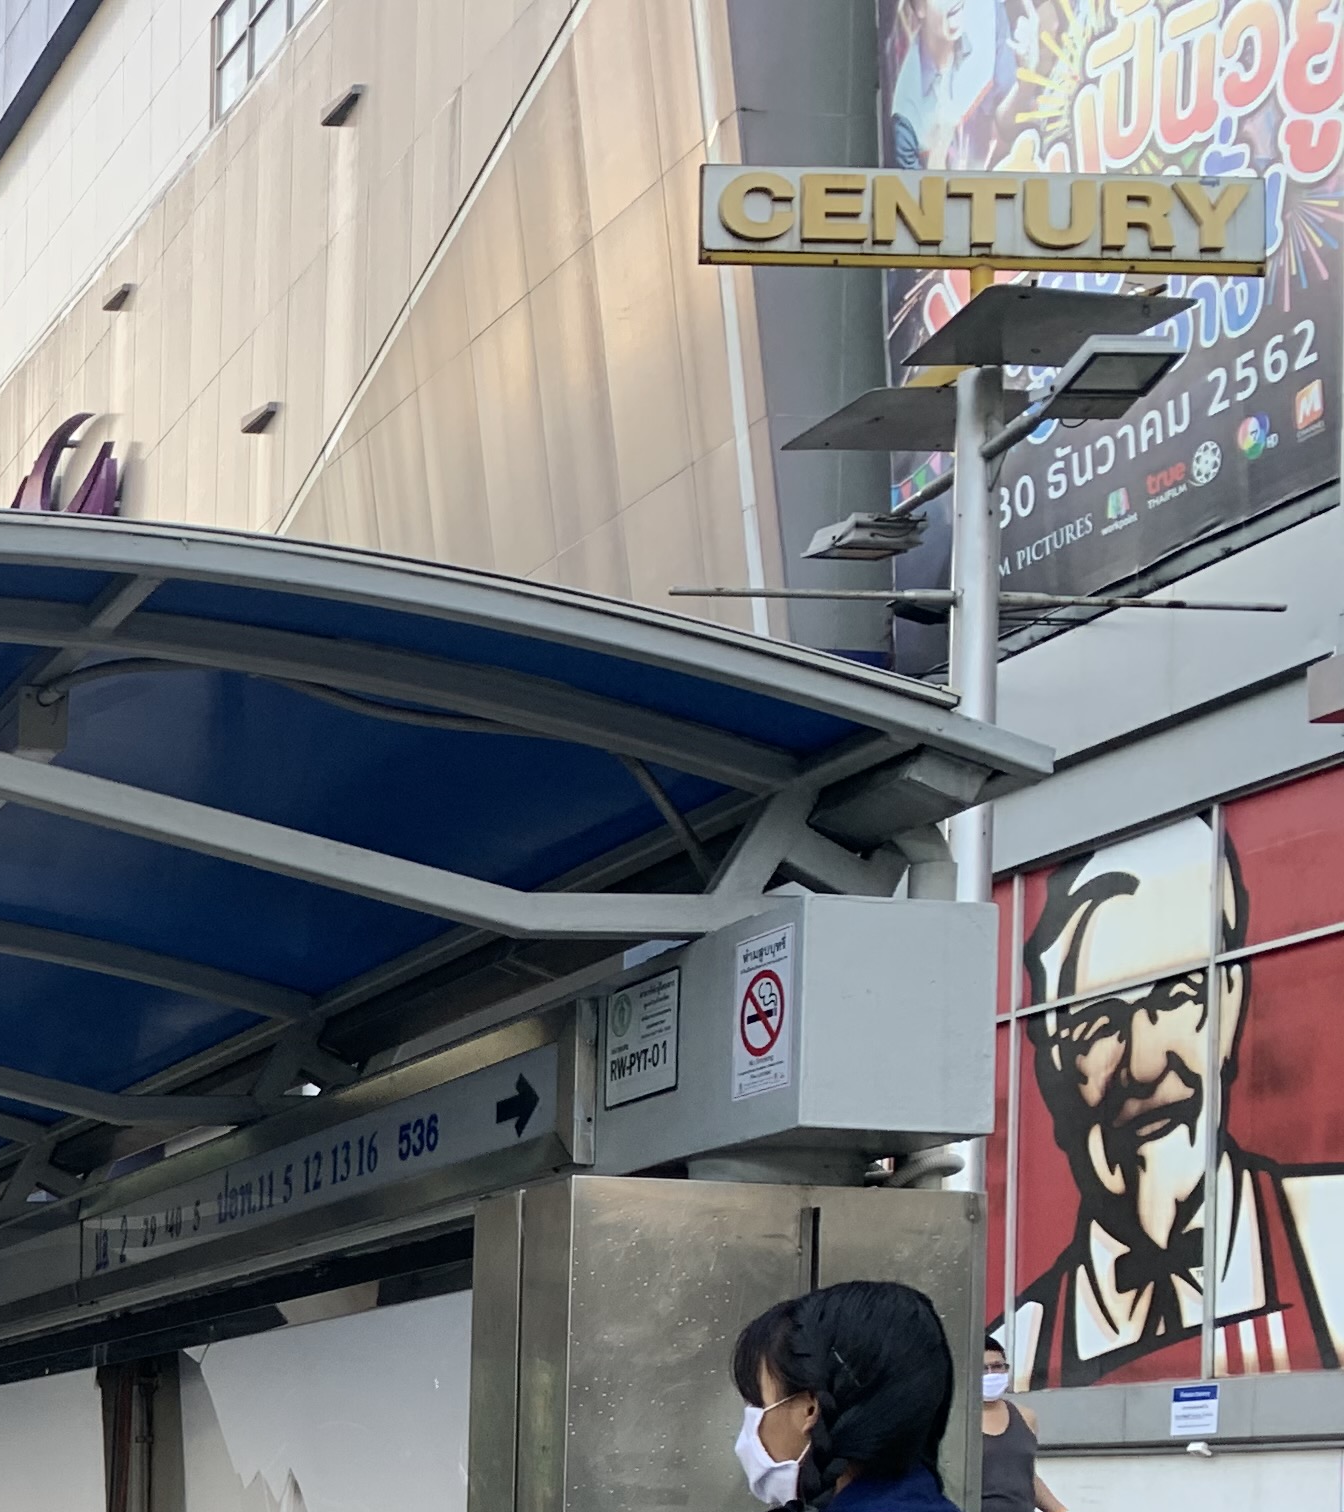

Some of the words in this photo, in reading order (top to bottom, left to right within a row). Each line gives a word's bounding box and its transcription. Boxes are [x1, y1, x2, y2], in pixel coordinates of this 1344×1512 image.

[719, 171, 1250, 252] CENTURY
[1047, 392, 1191, 500] ธันวาคม
[1207, 318, 1319, 416] 2562
[1145, 461, 1187, 494] true
[1147, 483, 1188, 509] THAIFILM
[1016, 513, 1093, 571] PICTURES
[1100, 511, 1139, 536] workpoint
[610, 1040, 668, 1082] RW-PYT-01
[303, 1150, 322, 1195] 12
[330, 1139, 351, 1185] 13
[356, 1130, 378, 1177] 16
[398, 1113, 439, 1162] 536
